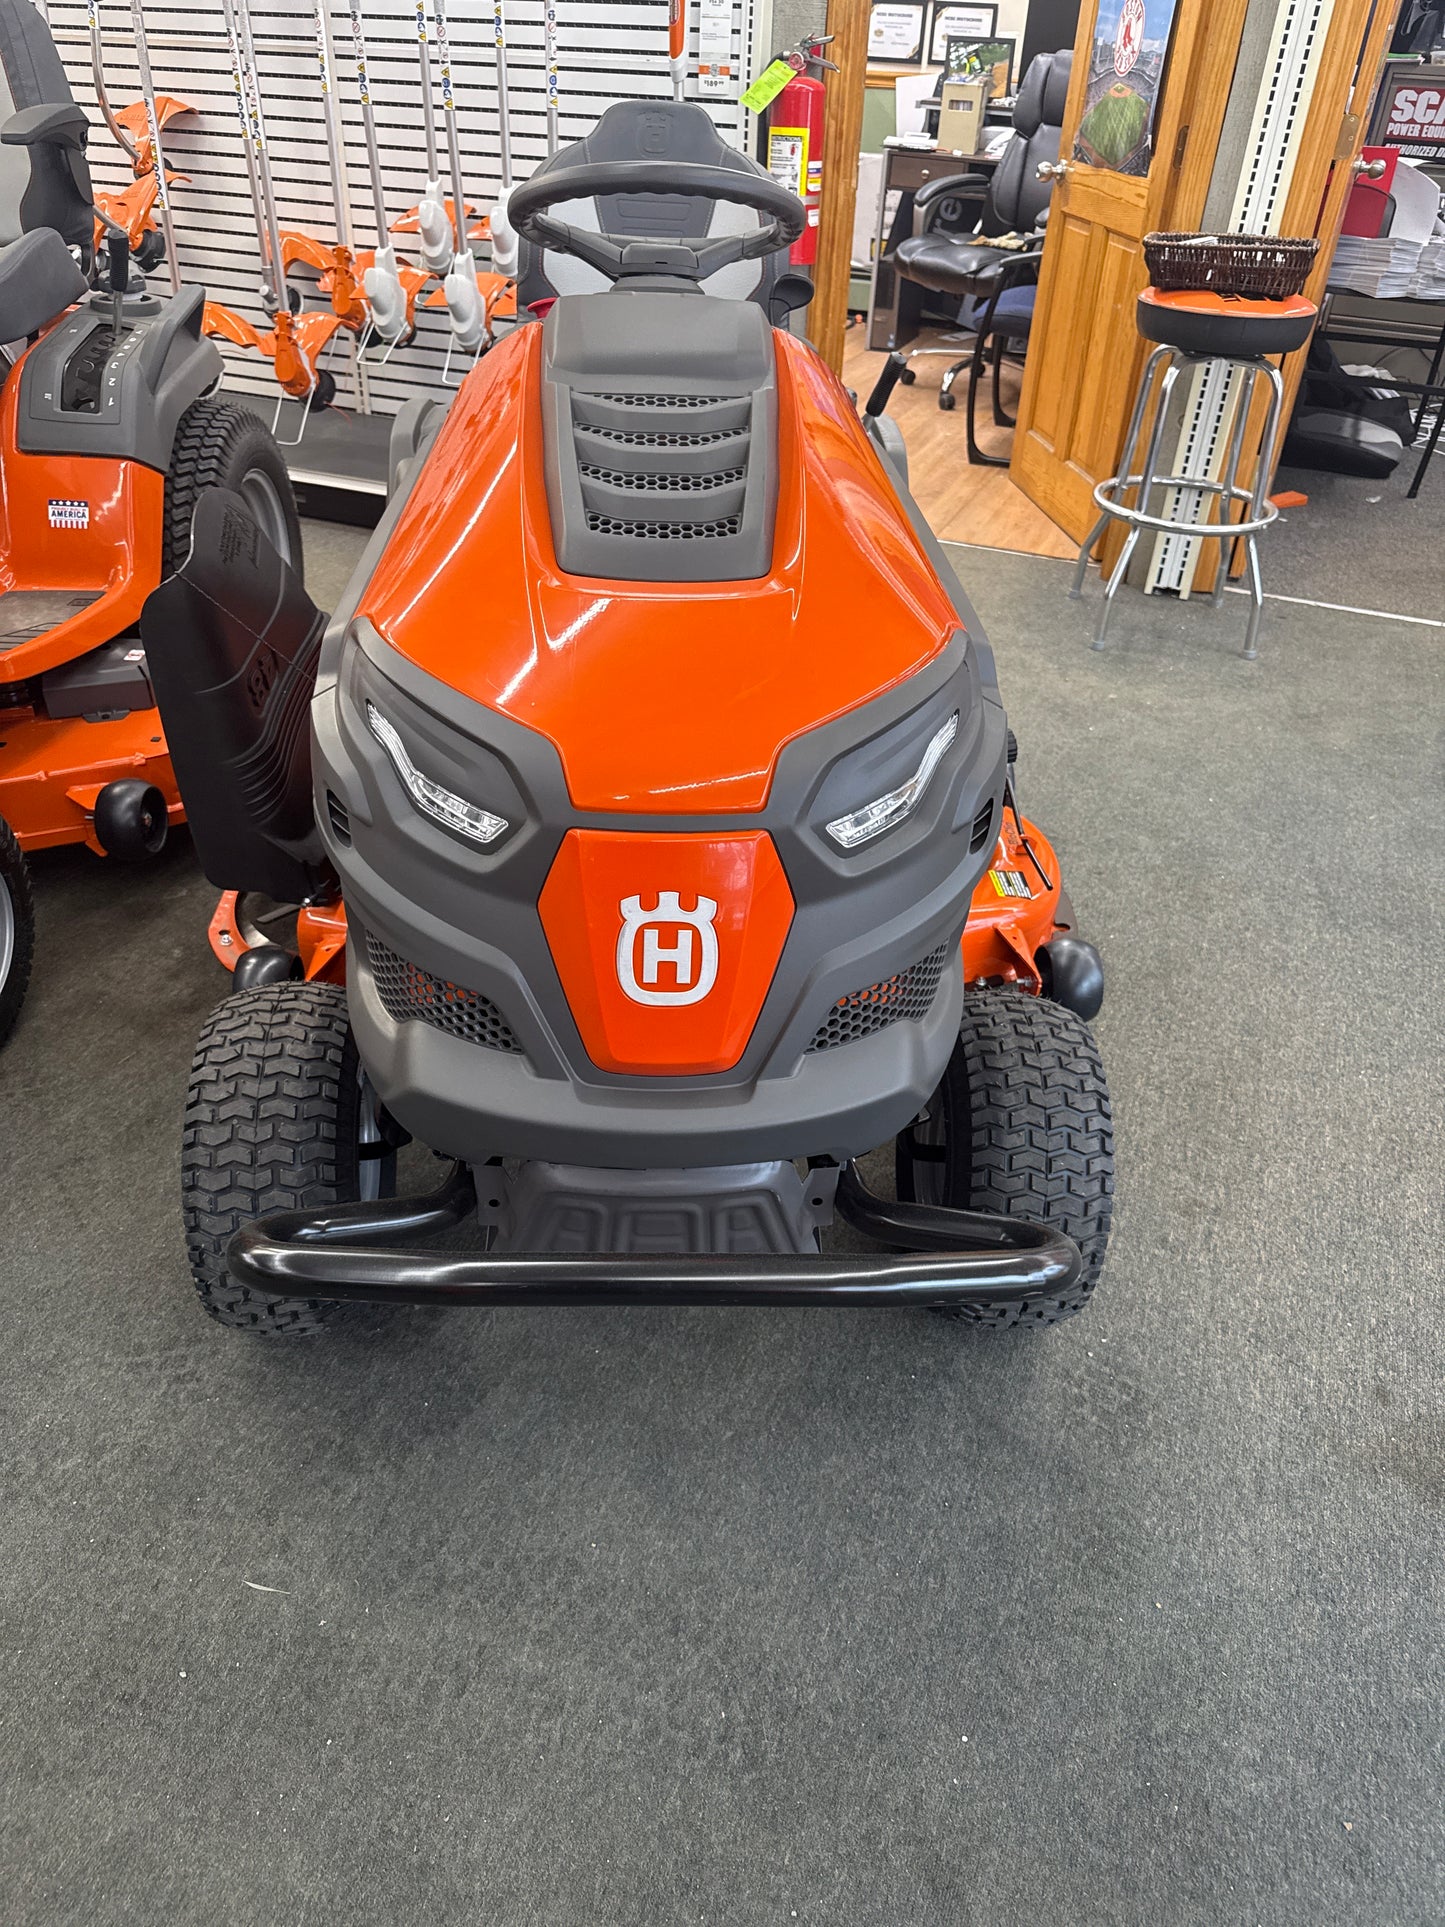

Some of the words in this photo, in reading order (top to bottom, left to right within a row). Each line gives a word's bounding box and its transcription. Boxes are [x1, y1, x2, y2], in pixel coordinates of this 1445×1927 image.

[1386, 122, 1421, 137] POWER
[109, 378, 116, 386] 2
[108, 397, 114, 406] 1
[51, 510, 87, 519] AMERICA
[643, 928, 692, 984] H
